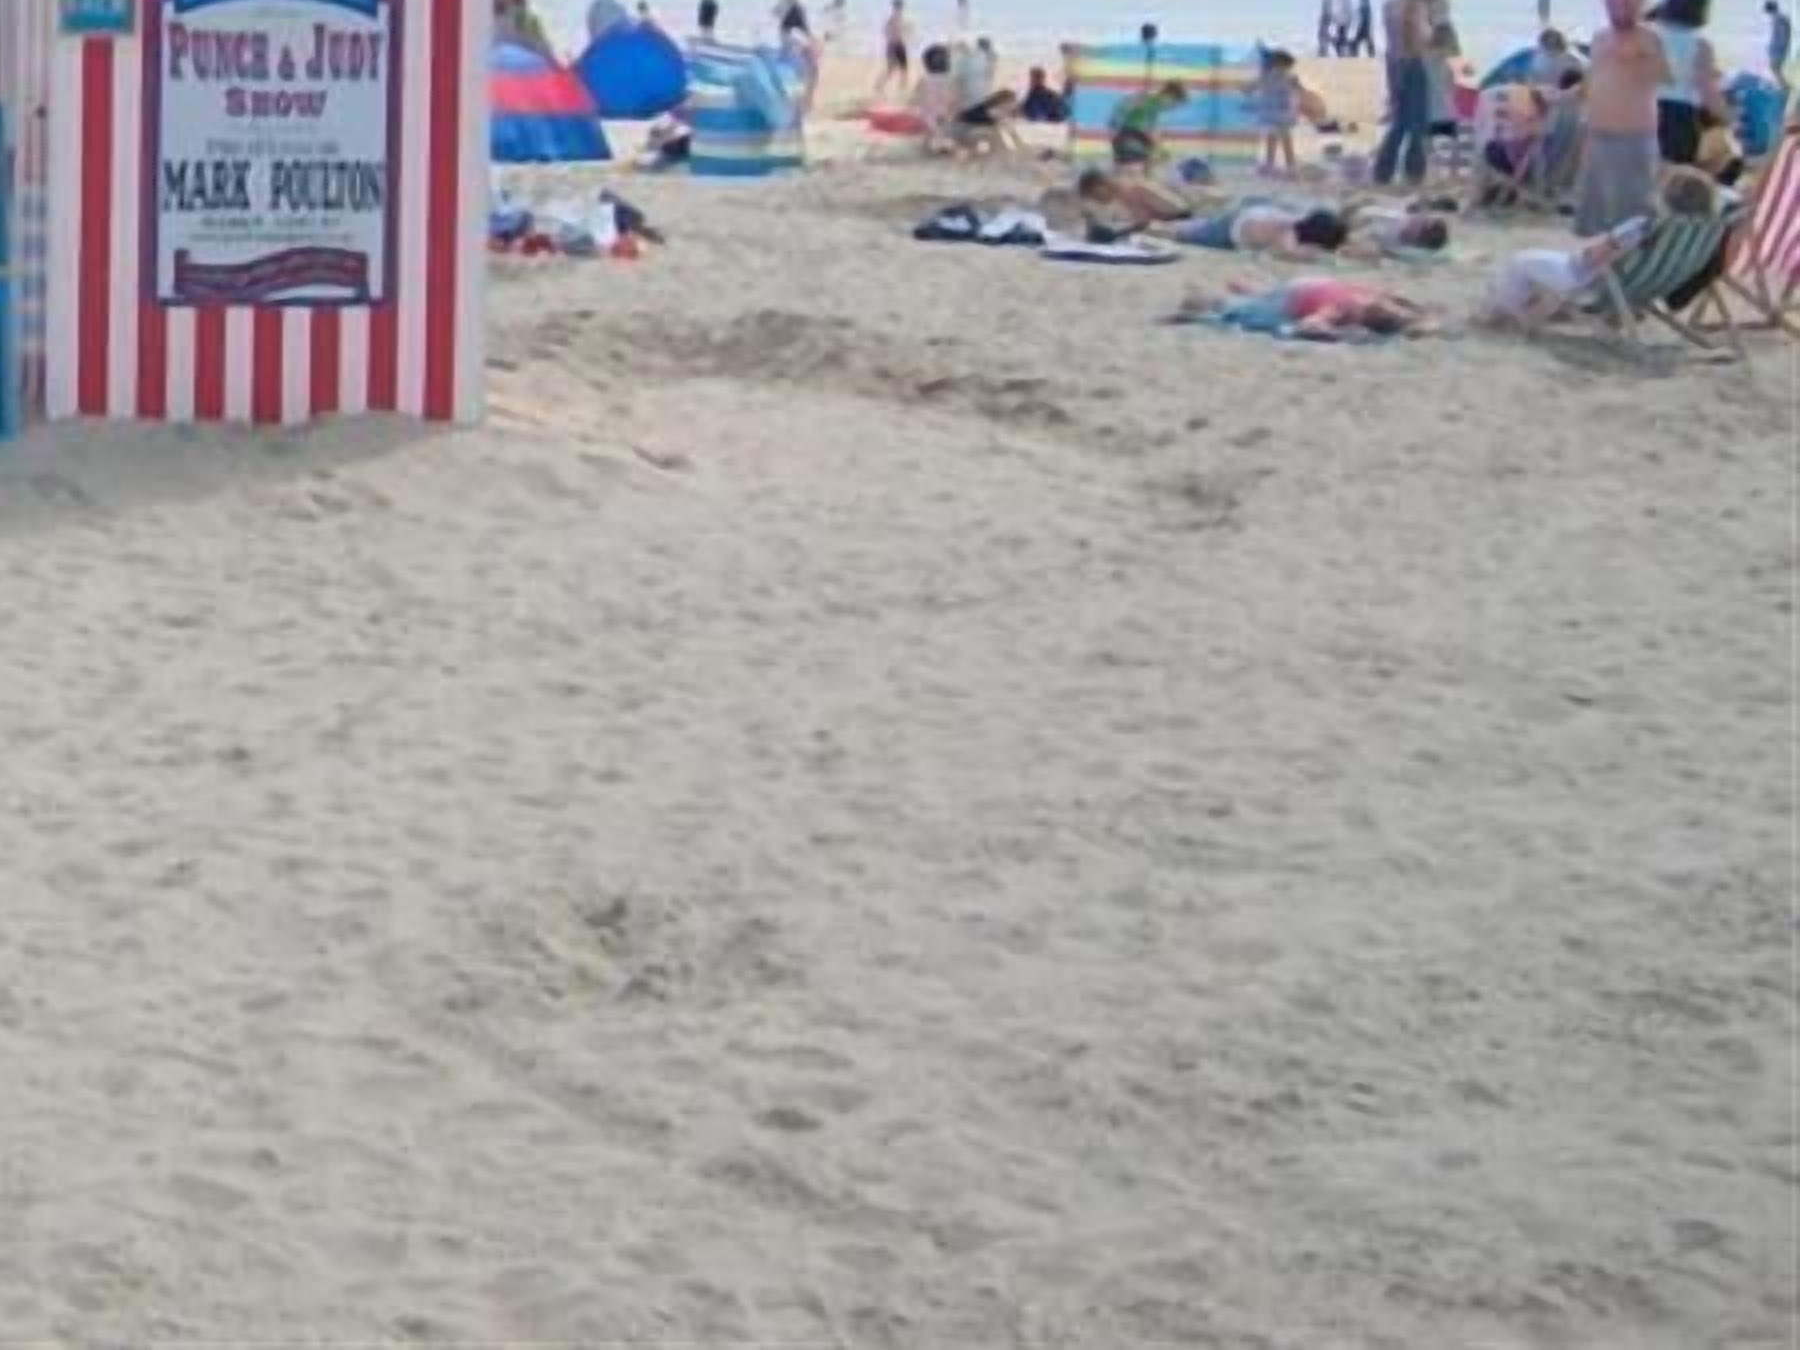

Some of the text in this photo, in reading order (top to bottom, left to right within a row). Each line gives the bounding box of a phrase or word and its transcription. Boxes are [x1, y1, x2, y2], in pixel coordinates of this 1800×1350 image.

[169, 22, 269, 81] PUNCH
[305, 23, 384, 80] JUDY
[225, 87, 327, 117] SHOW
[163, 159, 383, 212] MARK POULTON
